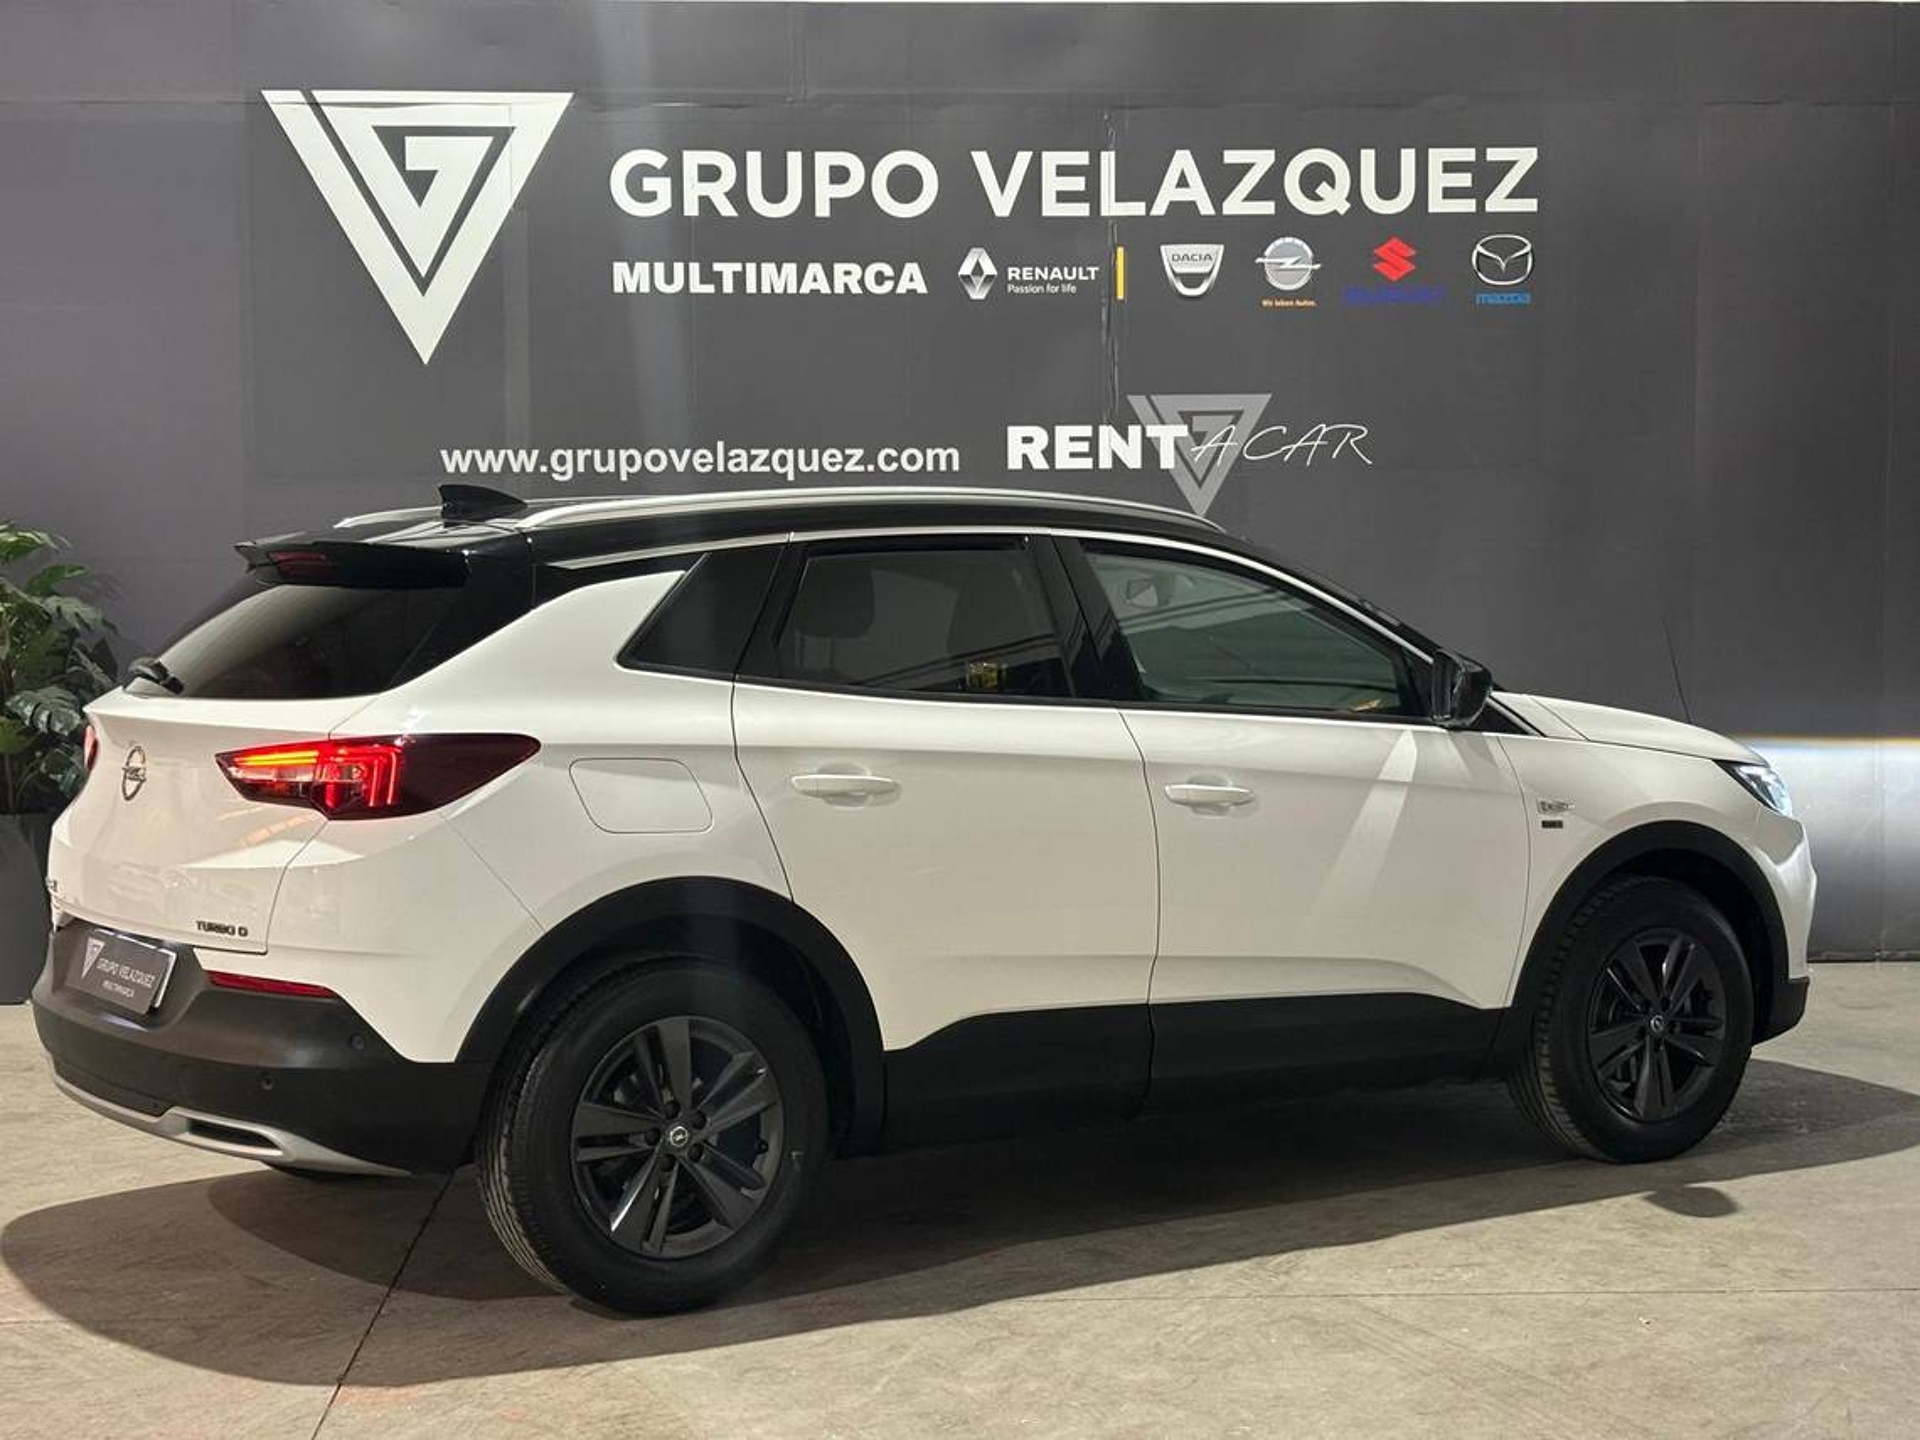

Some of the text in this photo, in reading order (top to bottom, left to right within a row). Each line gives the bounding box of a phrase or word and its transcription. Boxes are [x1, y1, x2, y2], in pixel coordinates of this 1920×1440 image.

[609, 147, 1539, 218] GRUPO VELAZQUEZ
[1171, 253, 1214, 262] DACIA
[612, 261, 929, 295] MULTIMARCA
[1007, 265, 1100, 281] RENAULT
[1007, 282, 1077, 294] Passion for life
[1006, 425, 1189, 470] RENT
[1242, 424, 1374, 467] CAR
[440, 441, 960, 481] www.grupovelazquez.com
[195, 920, 236, 936] TURBO
